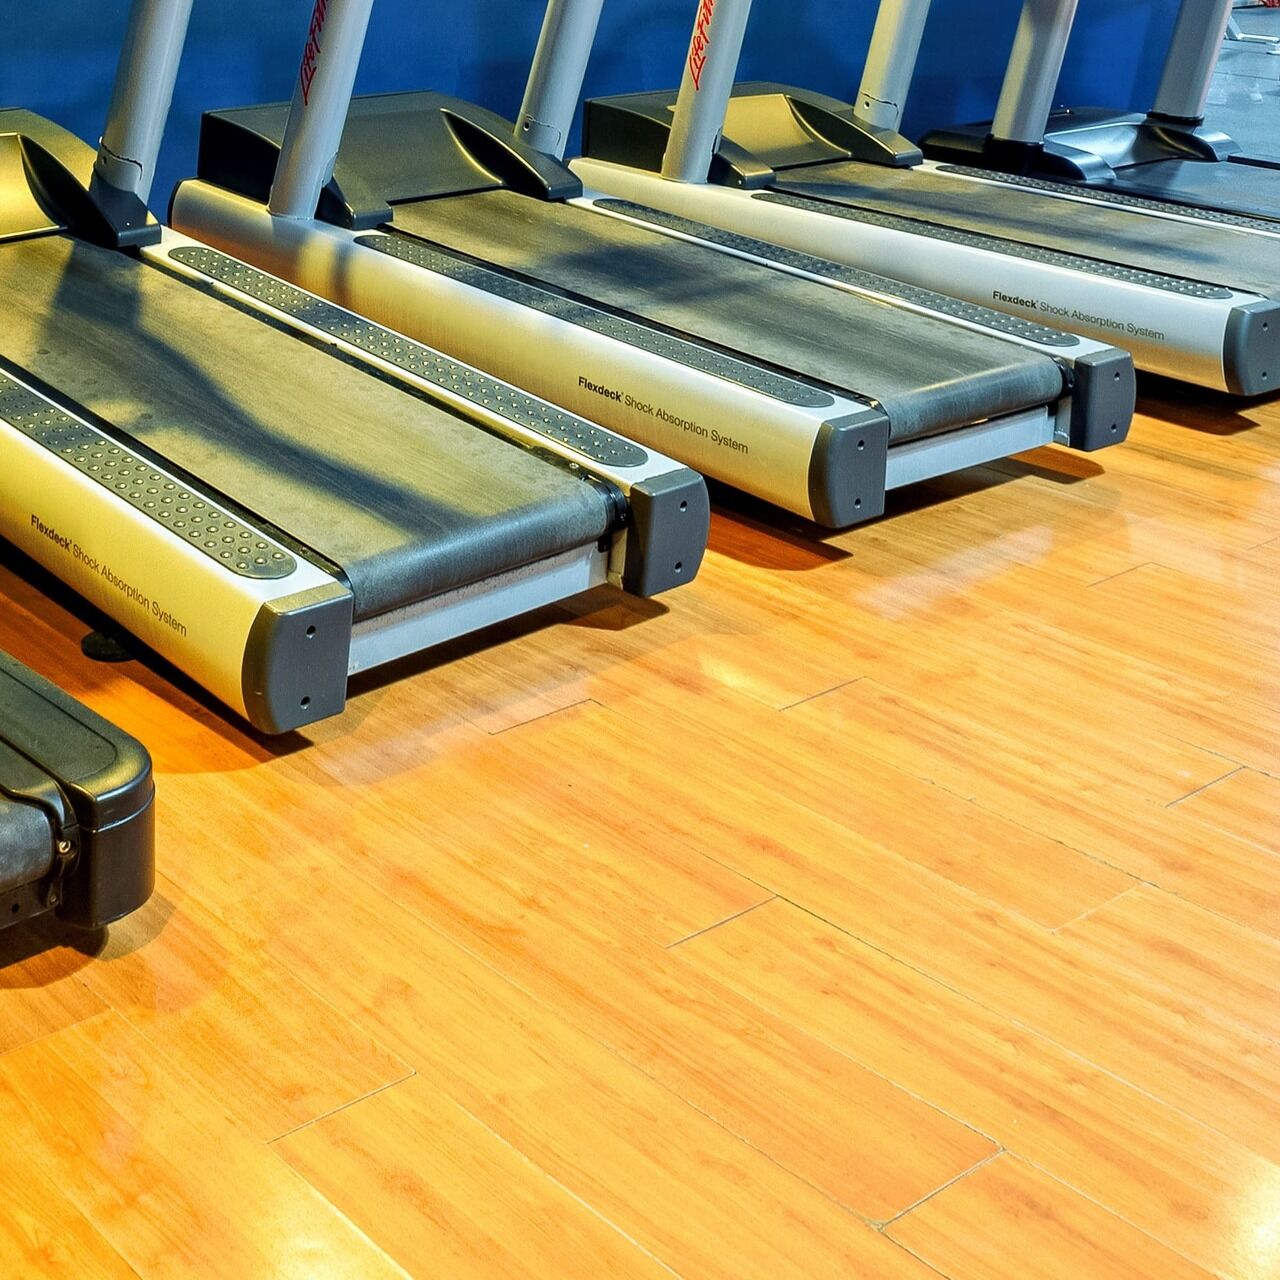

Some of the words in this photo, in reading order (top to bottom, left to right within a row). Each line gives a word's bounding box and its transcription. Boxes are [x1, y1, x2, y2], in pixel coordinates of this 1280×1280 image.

[689, 35, 706, 91] Life
[1040, 301, 1069, 318] Shock
[1071, 310, 1124, 330] Absorption
[1127, 323, 1165, 341] System
[624, 395, 654, 417] Shock
[655, 408, 708, 438] Absorption
[711, 430, 749, 454] System
[73, 544, 100, 574] Shock
[100, 565, 150, 612] Absorption
[151, 601, 187, 637] System
